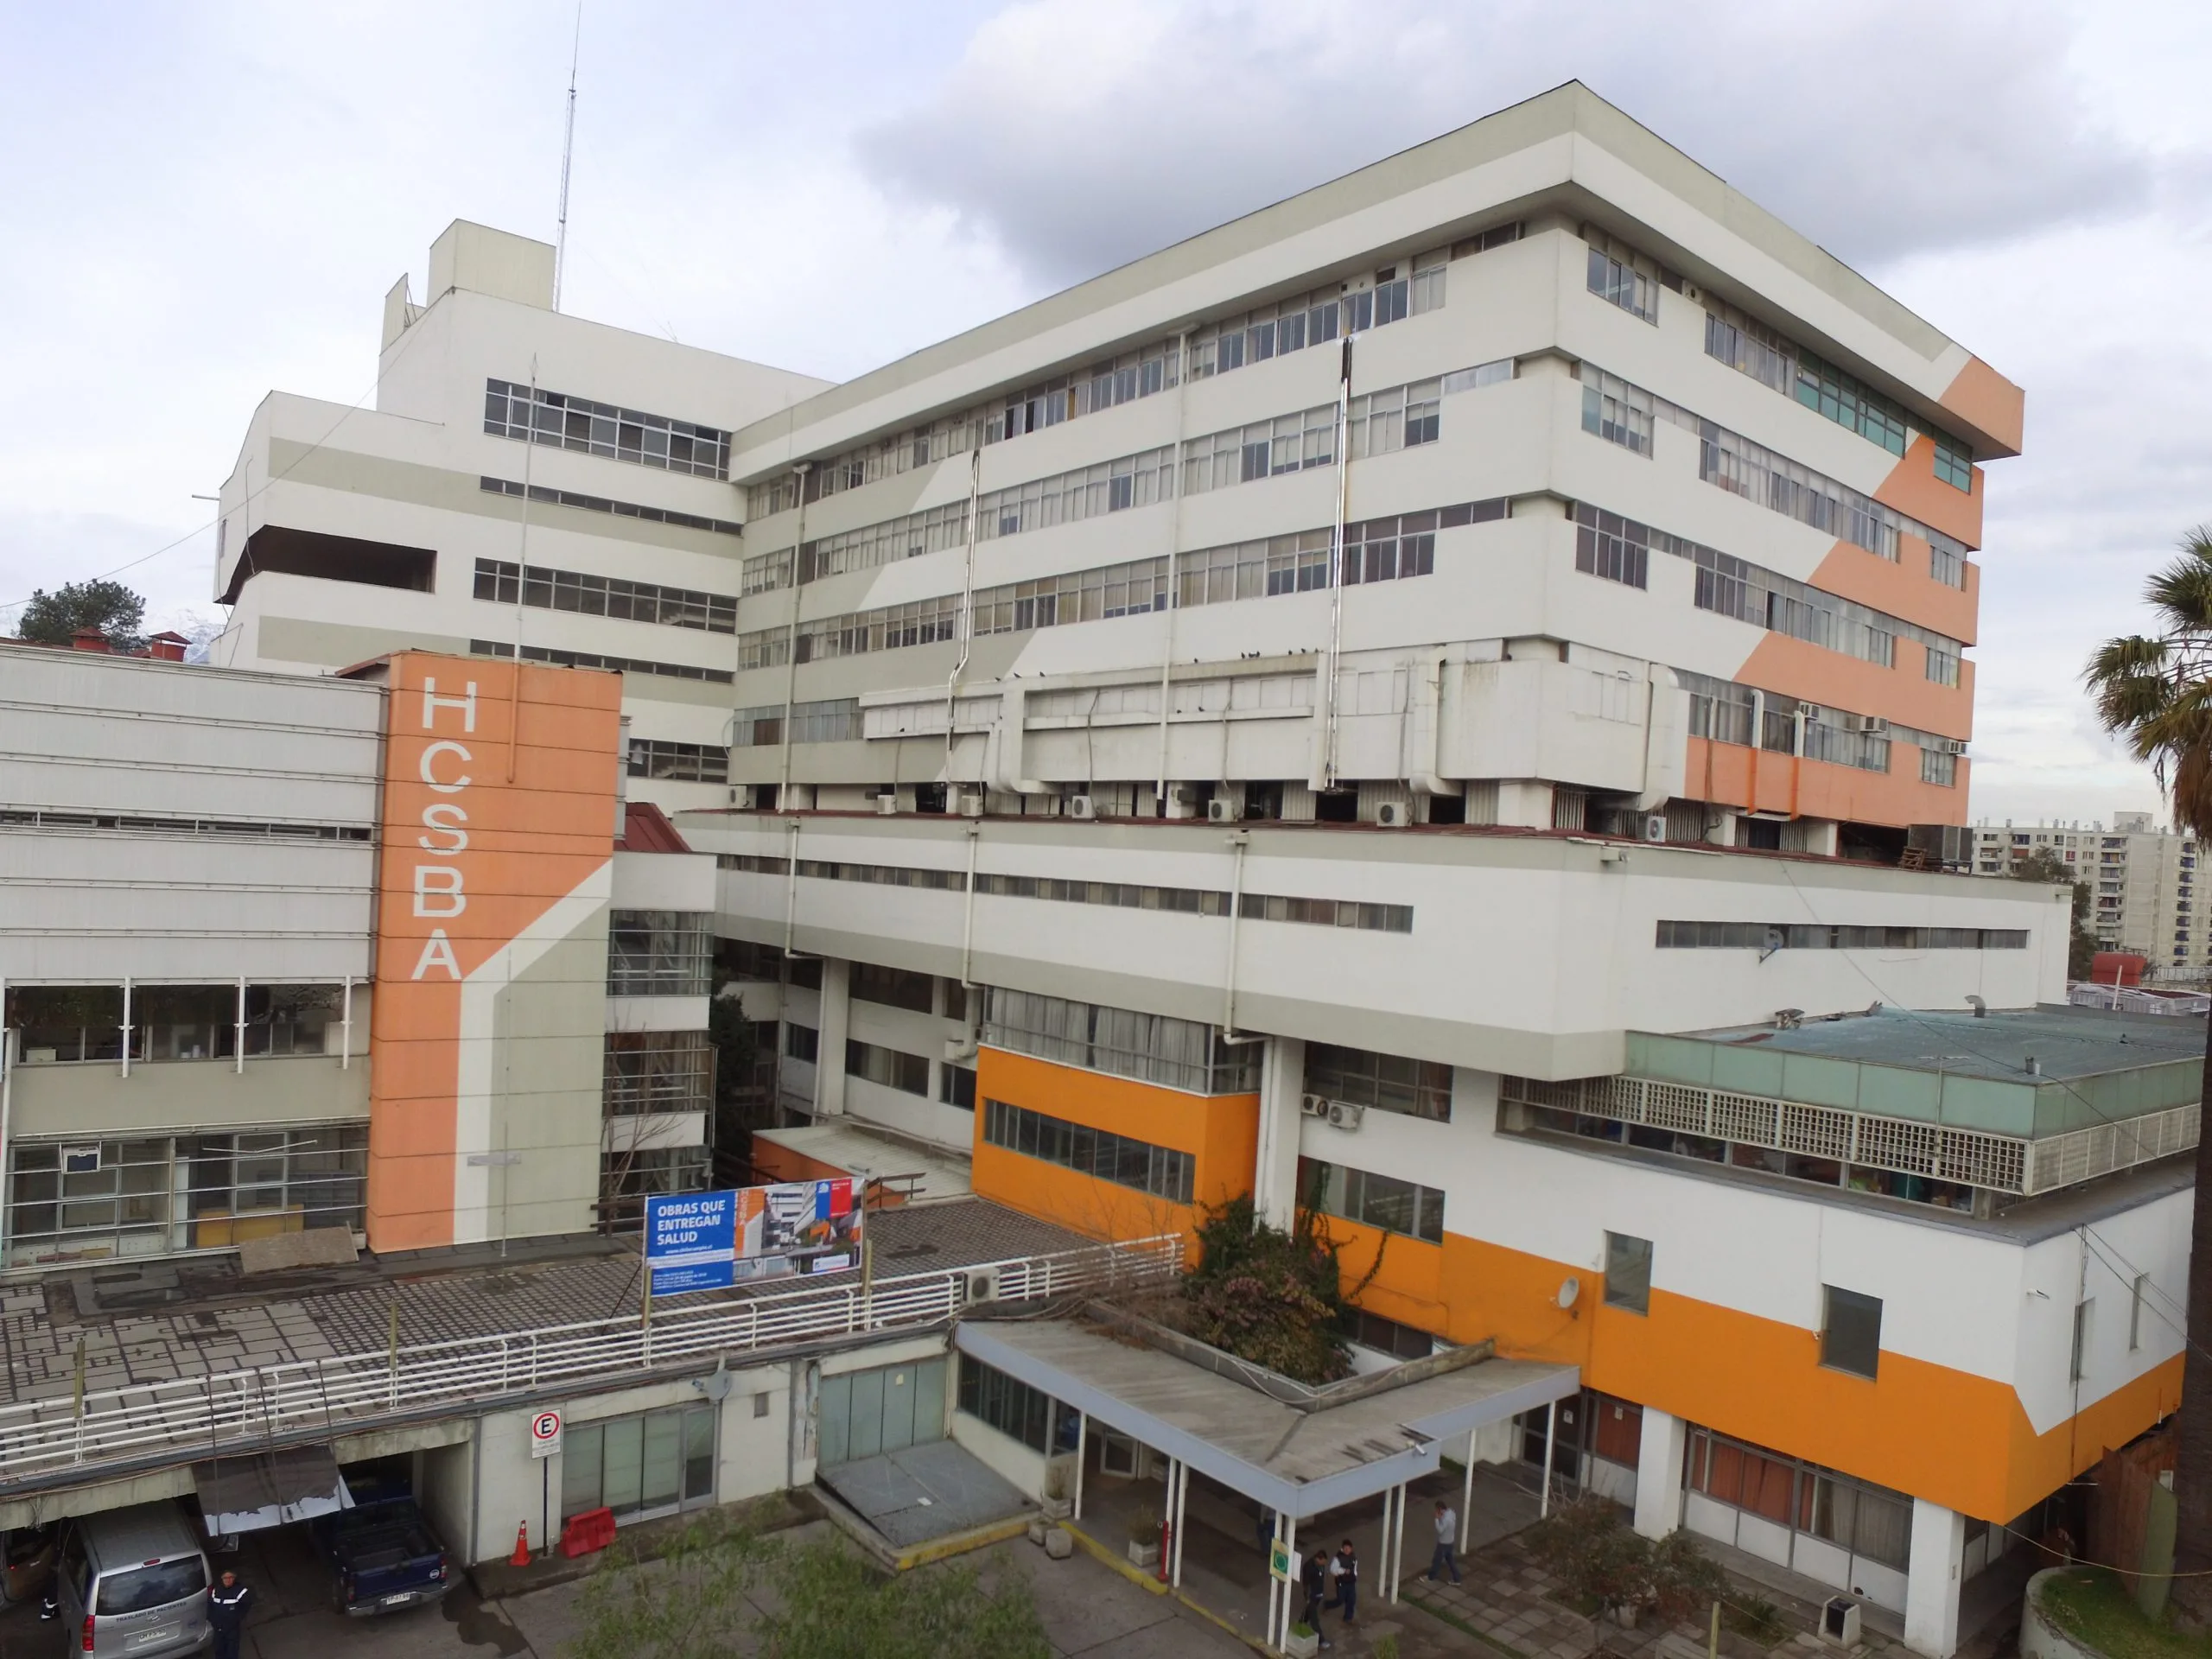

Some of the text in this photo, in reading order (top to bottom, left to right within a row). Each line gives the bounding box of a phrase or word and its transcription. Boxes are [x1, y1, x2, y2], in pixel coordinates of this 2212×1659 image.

[411, 677, 477, 981] HCSBA
[658, 1199, 726, 1217] OBRAS QUE
[658, 1214, 721, 1231] ENTREGAN
[657, 1230, 698, 1246] SALUD
[541, 1417, 552, 1434] E
[117, 1611, 146, 1622] TRASLADO
[156, 1602, 187, 1612] PACIENTES
